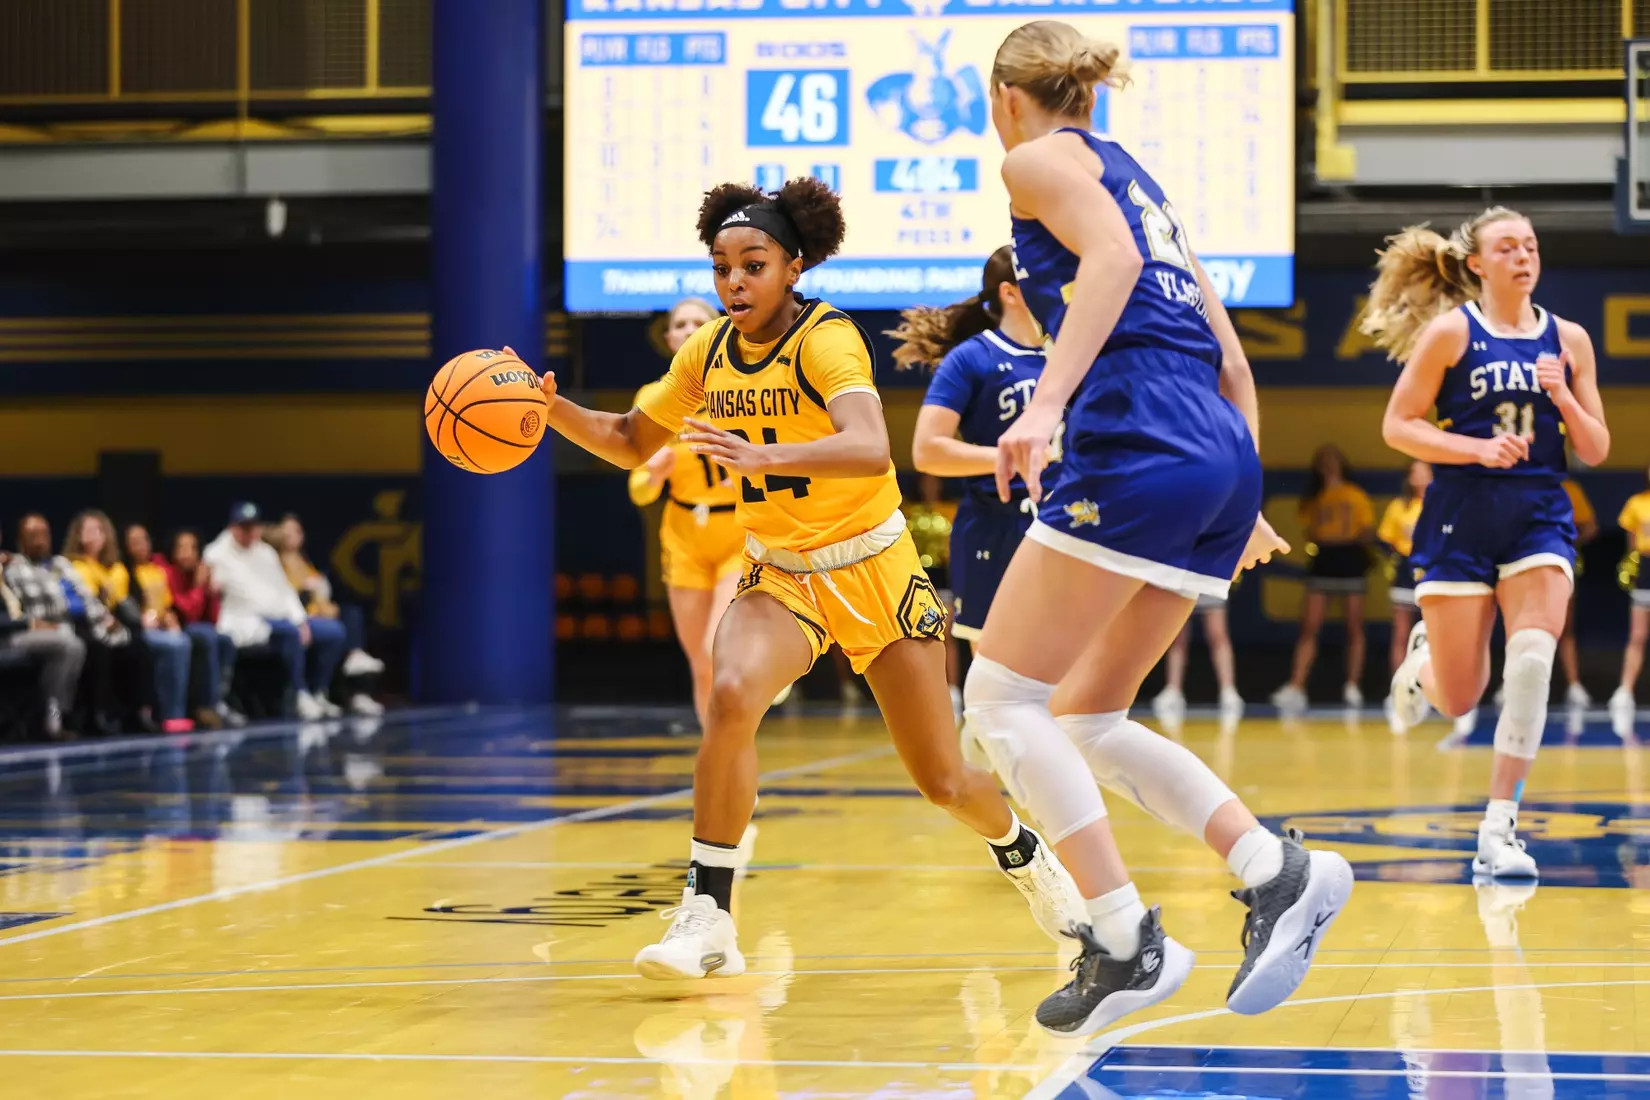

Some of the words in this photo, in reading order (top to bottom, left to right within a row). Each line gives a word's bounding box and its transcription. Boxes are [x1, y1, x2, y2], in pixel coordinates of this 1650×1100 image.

[760, 73, 839, 143] 46
[1470, 361, 1553, 401] STAT
[760, 387, 800, 417] CITY
